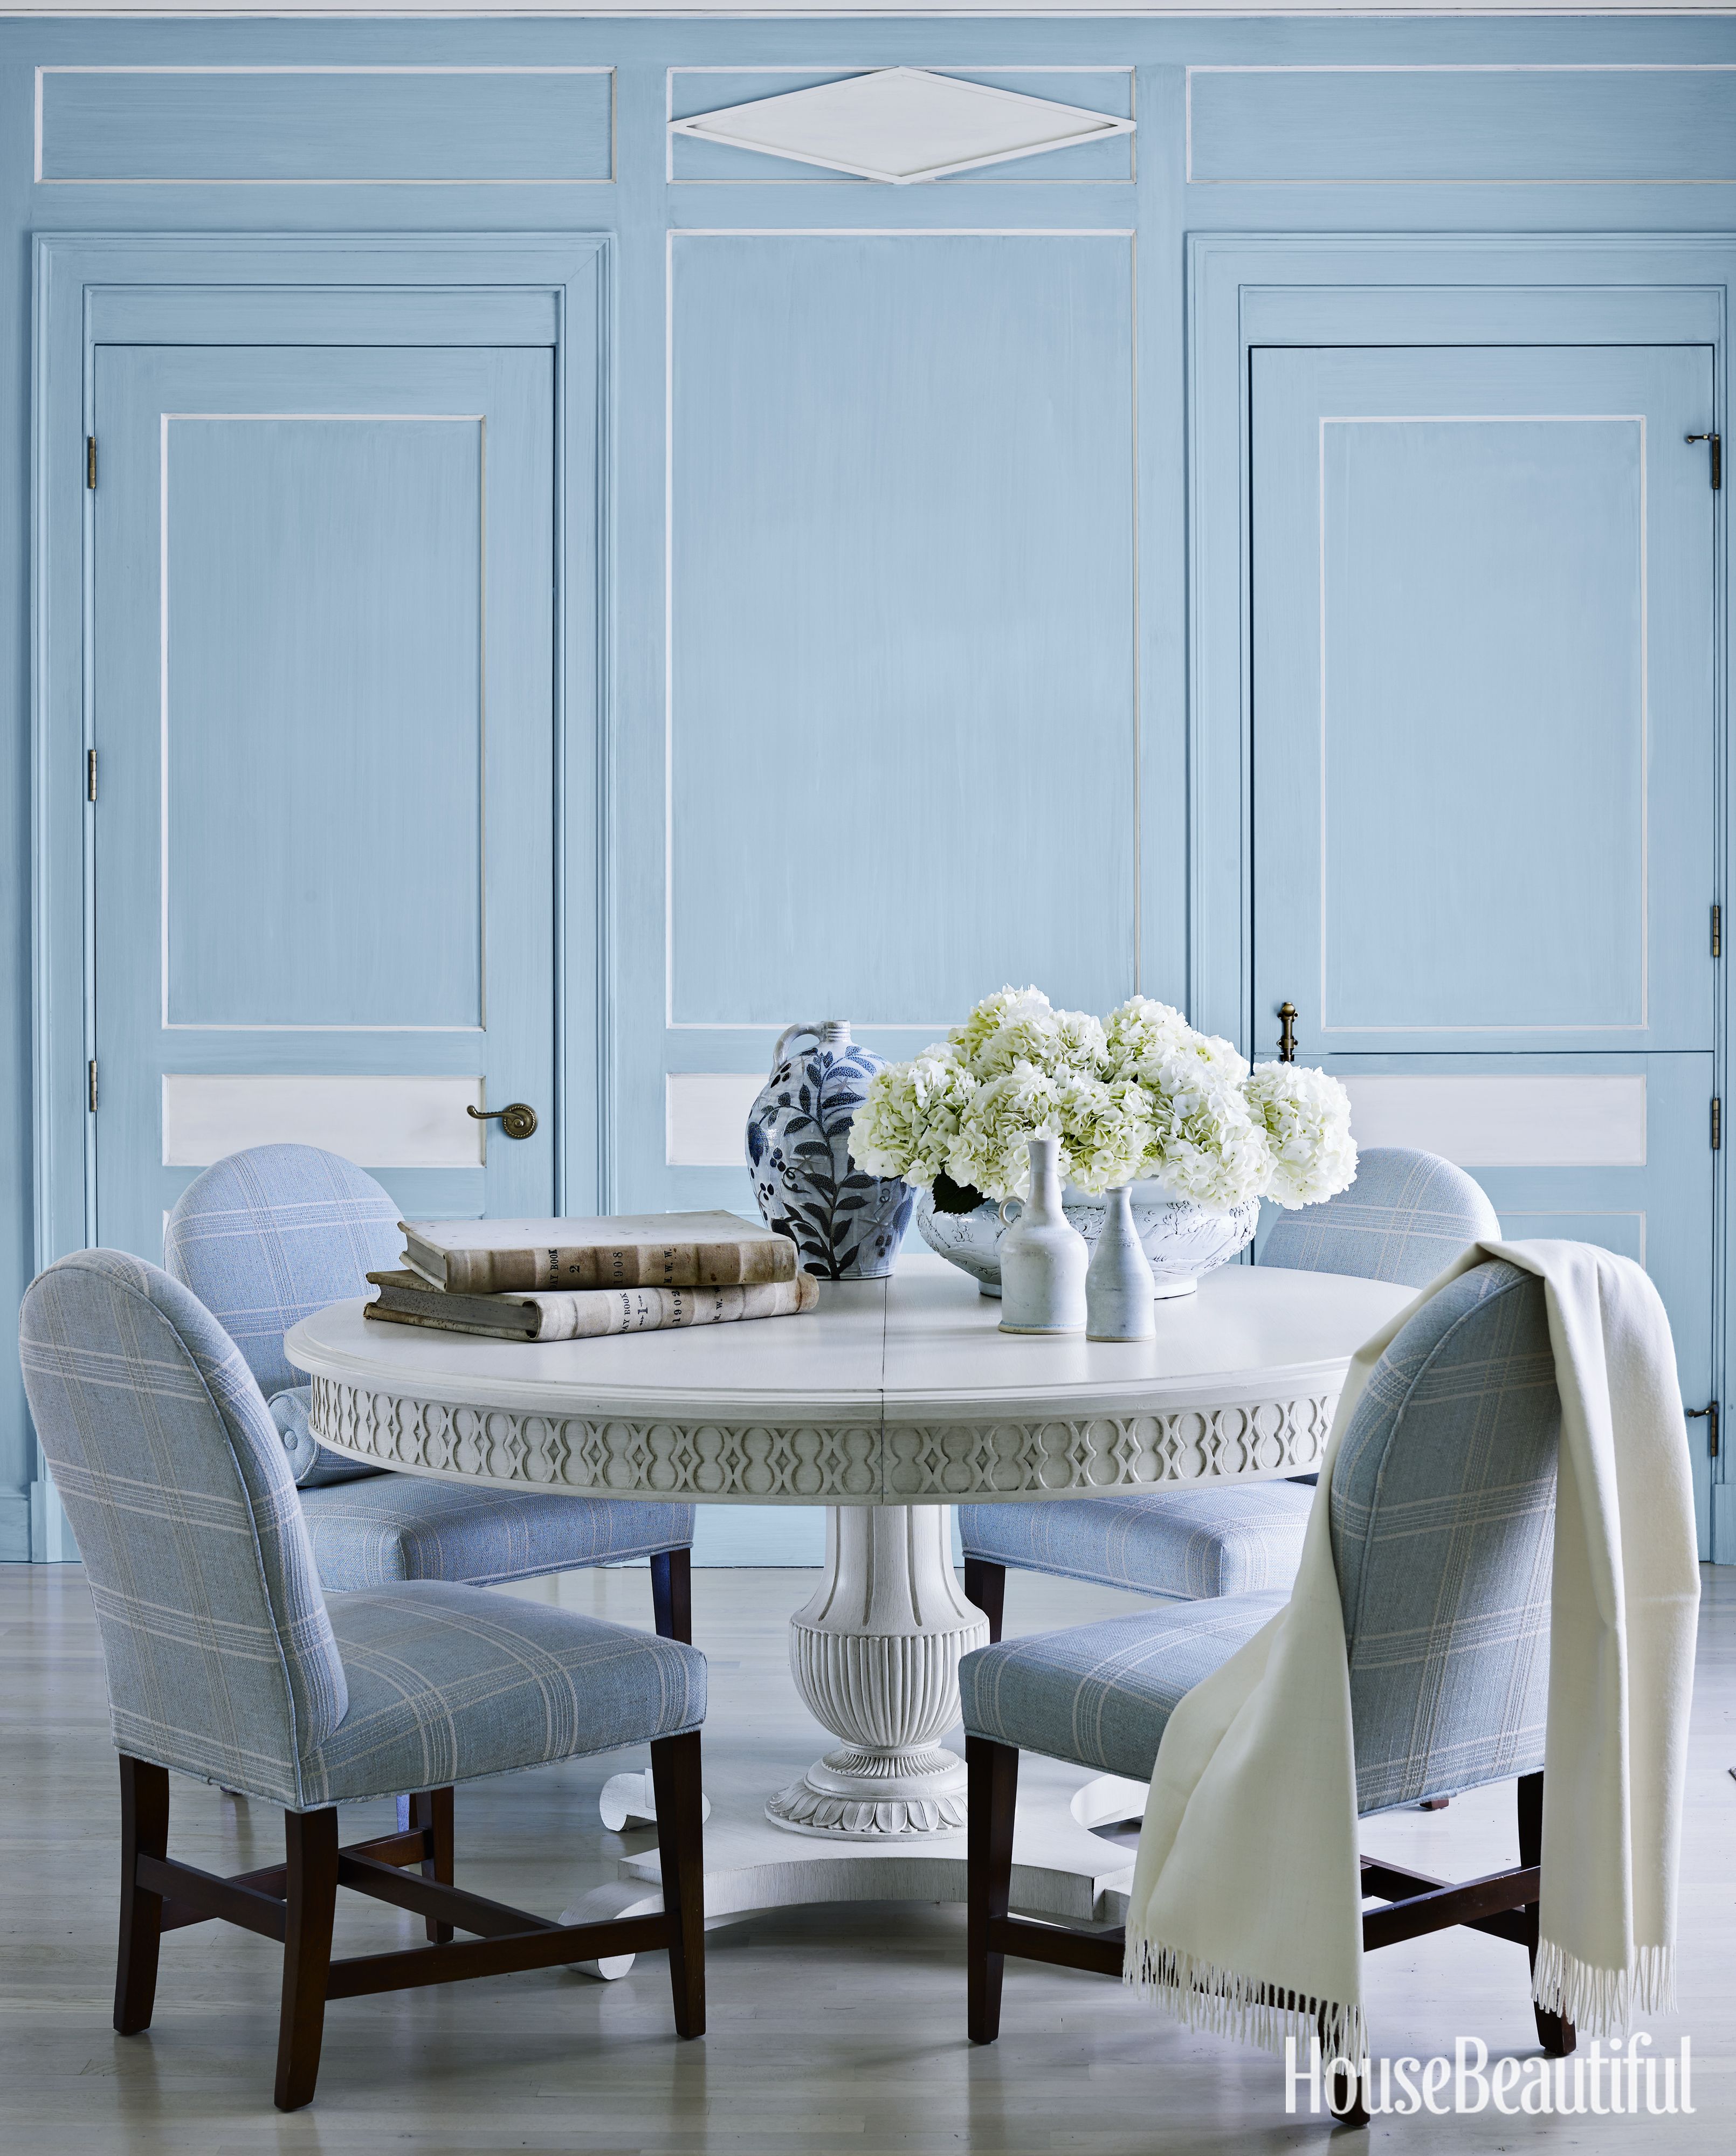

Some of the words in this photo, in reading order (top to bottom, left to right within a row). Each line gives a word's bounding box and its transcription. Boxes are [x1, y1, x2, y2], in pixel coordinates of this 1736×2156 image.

[548, 1249, 559, 1271] BOOK
[569, 1265, 580, 1273] 2
[613, 1252, 623, 1284] 1908
[664, 1262, 673, 1273] W.
[549, 1275, 559, 1289] DAY
[619, 1293, 631, 1316] BOOK
[671, 1290, 682, 1323] 1902
[618, 1319, 630, 1333] DAY
